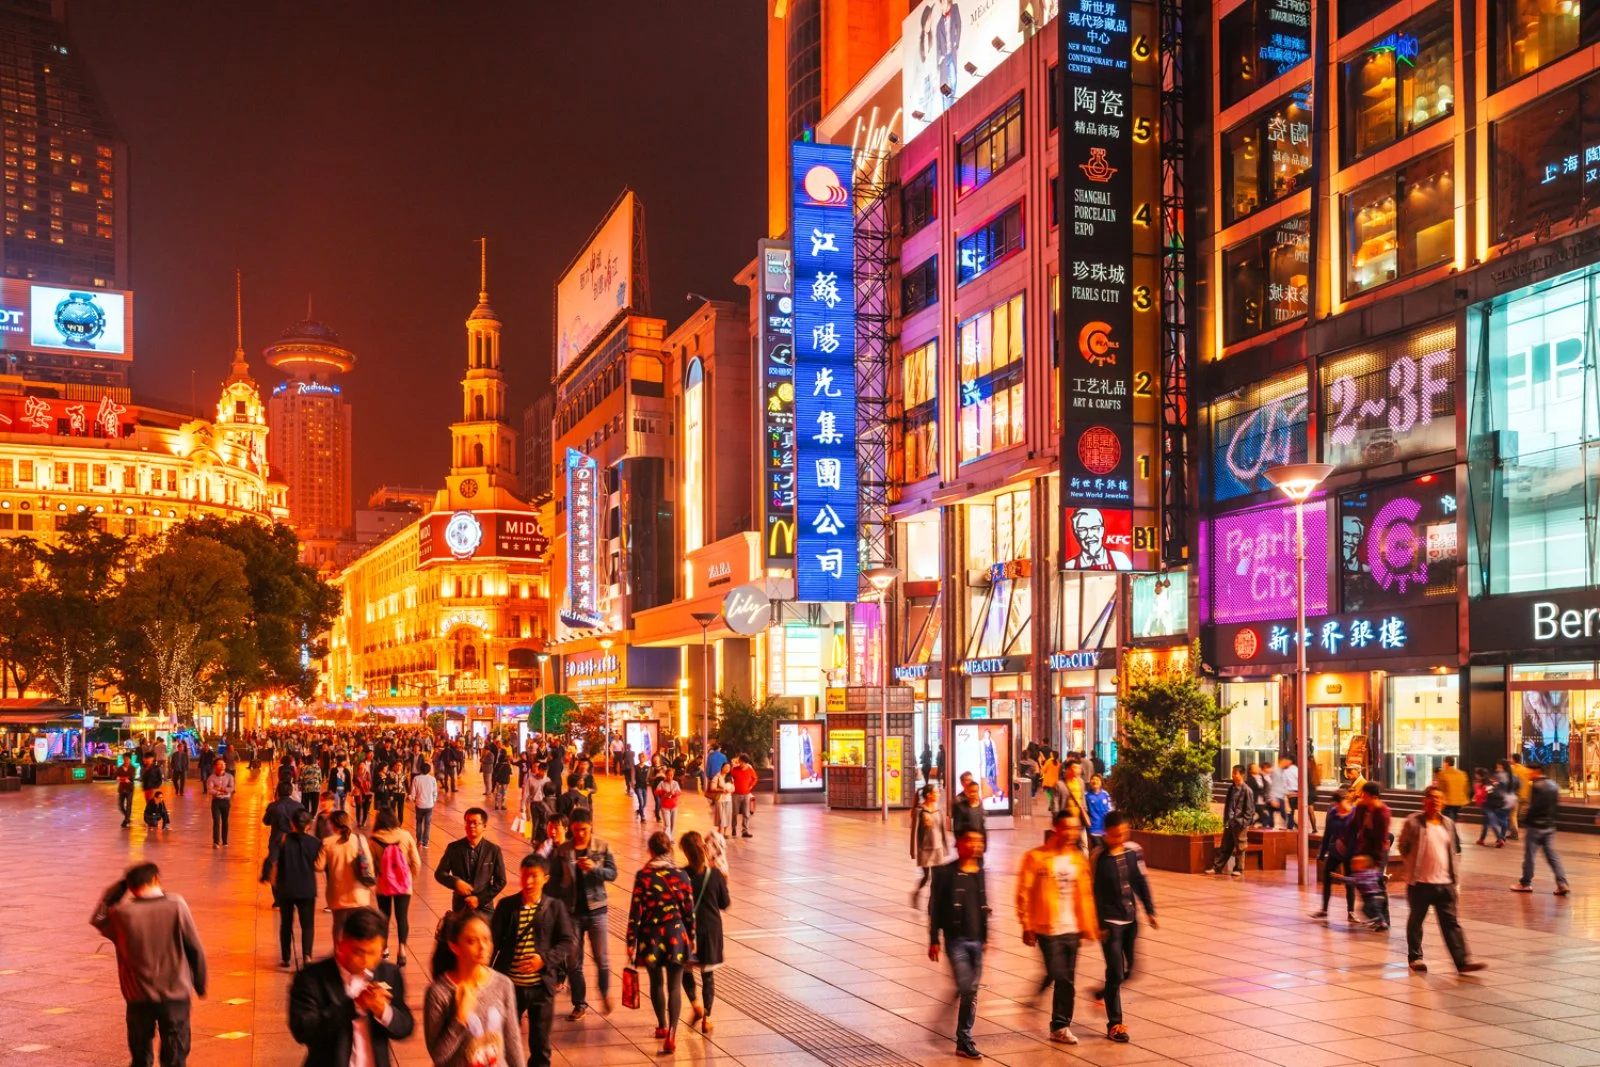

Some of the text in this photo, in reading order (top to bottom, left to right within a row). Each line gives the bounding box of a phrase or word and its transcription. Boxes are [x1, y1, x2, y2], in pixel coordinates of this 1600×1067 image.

[1080, 0, 1116, 16] 新世界
[1068, 12, 1128, 32] 现代珍藏品
[1087, 30, 1110, 44] 中心
[1068, 42, 1102, 54] NEW WORLD
[1131, 34, 1150, 61] 6
[1068, 52, 1128, 69] CONTEMPORARY ART
[1068, 63, 1092, 74] CENTER
[1074, 86, 1124, 118] 陶瓷
[1074, 120, 1120, 139] 精品商场
[1132, 116, 1151, 143] 5
[1074, 188, 1111, 205] SHANGHAI
[1074, 205, 1117, 222] PORCELAIN
[1132, 202, 1152, 229] 4
[1074, 222, 1094, 236] EXPO
[1073, 261, 1125, 284] 珍珠城
[1072, 286, 1120, 303] PEARLS CITY
[1133, 285, 1151, 313] 3
[297, 381, 333, 395] Radisson
[1072, 378, 1126, 396] 工艺礼品
[1133, 371, 1152, 398] 2
[809, 228, 846, 579] 江蘇陽光集團公司
[1073, 397, 1121, 410] ART & CRAFTS
[772, 433, 782, 508] SILK KING
[1137, 453, 1150, 479] 1
[1105, 492, 1129, 500] Jewelers
[769, 515, 778, 523] B1
[1106, 535, 1131, 545] KFC
[1133, 525, 1156, 552] B1
[1226, 520, 1308, 563] Pearl
[708, 561, 731, 579] ZARA
[1534, 602, 1600, 640] Ber
[1268, 617, 1408, 657] 新世界銀樓
[964, 657, 1004, 674] ME&CITY
[1050, 649, 1099, 669] ME&CITY
[895, 664, 927, 681] ME&CITY
